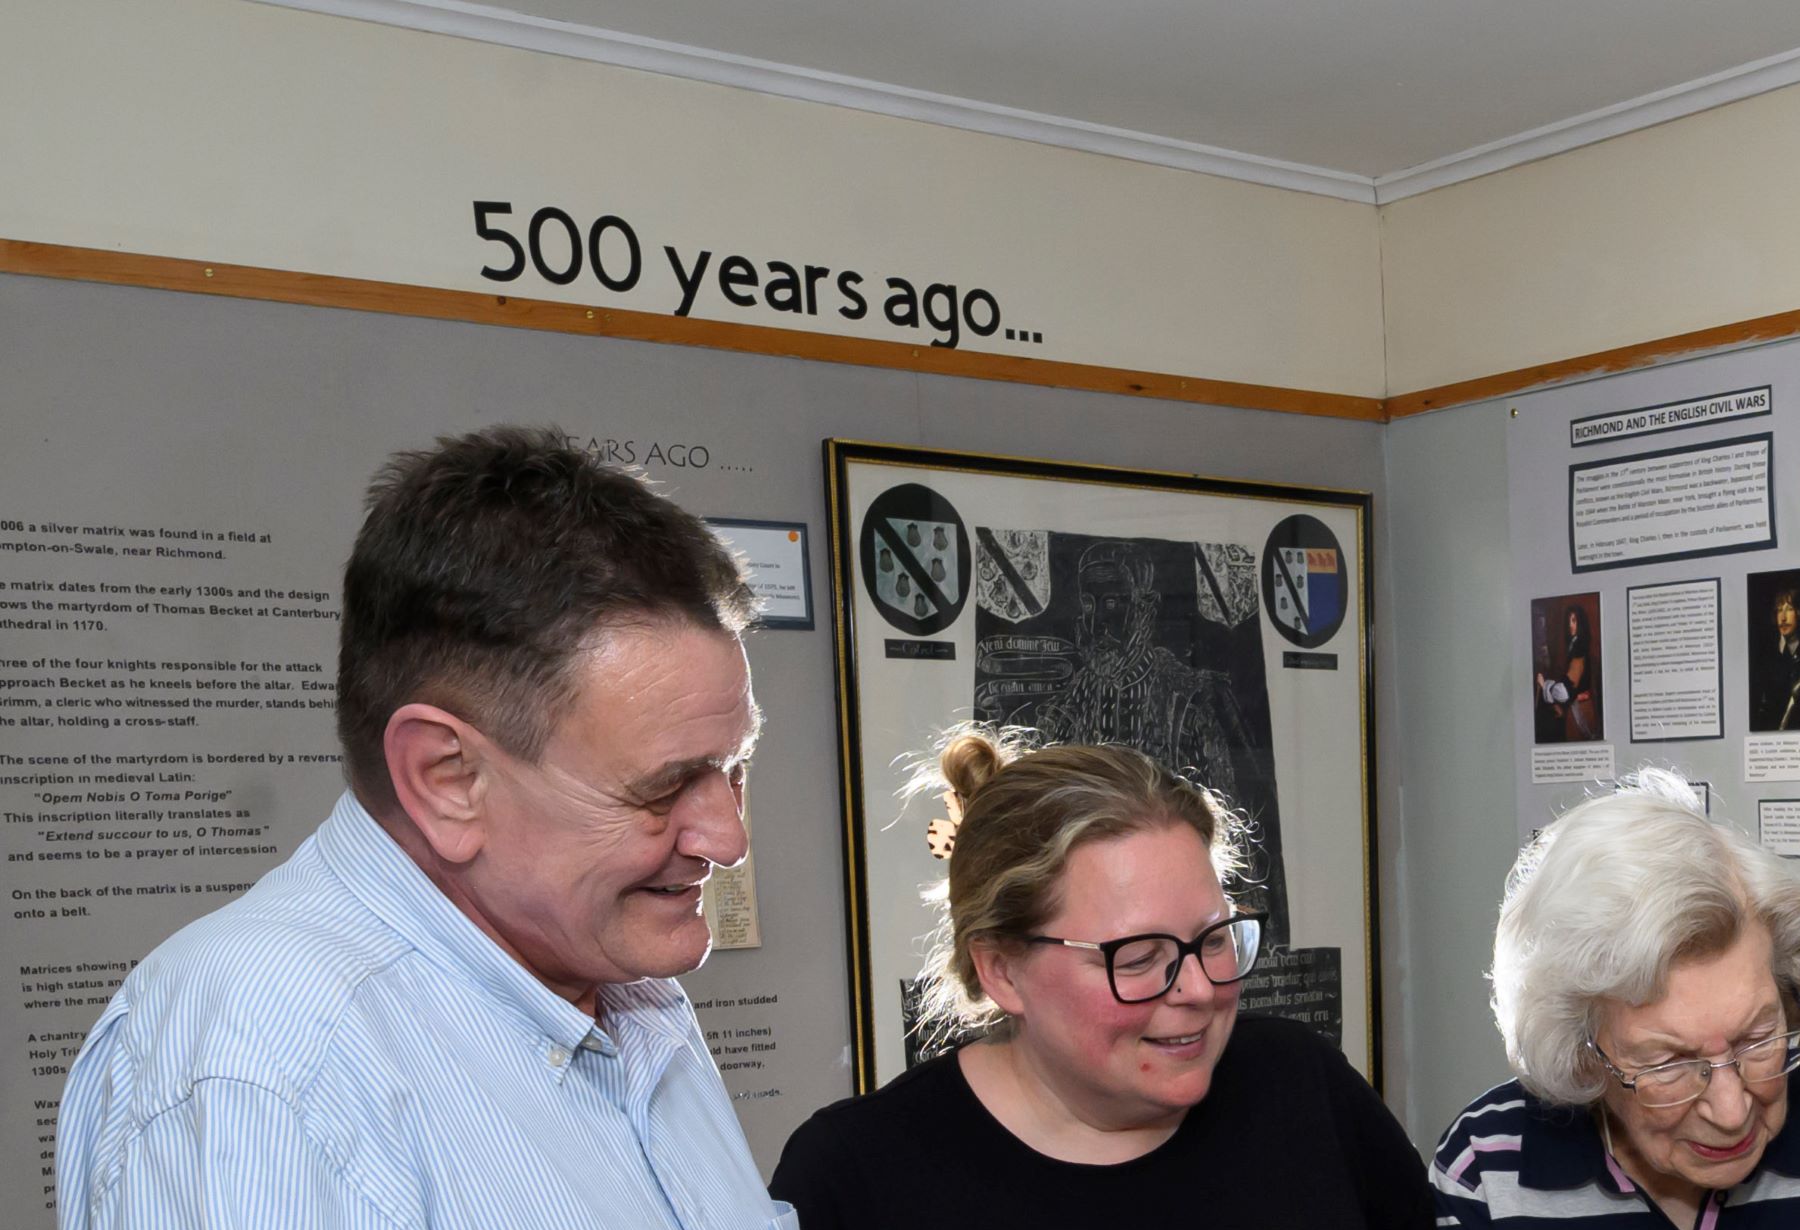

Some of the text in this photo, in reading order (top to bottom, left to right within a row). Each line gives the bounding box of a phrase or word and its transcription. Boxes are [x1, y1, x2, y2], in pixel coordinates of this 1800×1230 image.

[472, 199, 1044, 350] 500 years ago...
[1575, 393, 1766, 440] RICHMOND AND THE ENGLISH CIVIL WARS
[566, 435, 636, 464] EARS
[644, 442, 710, 469] AGO
[28, 524, 36, 532] a
[41, 523, 78, 534] silver
[83, 525, 126, 537] matrix
[129, 528, 155, 538] was
[160, 528, 197, 540] found
[201, 531, 213, 541] in
[217, 533, 225, 541] a
[228, 531, 256, 543] field
[260, 534, 271, 543] at
[123, 547, 151, 556] near
[156, 547, 227, 560] Richmond.
[11, 581, 54, 592] matrix
[59, 581, 96, 592] dates
[100, 583, 131, 594] from
[135, 584, 156, 595] the
[160, 586, 192, 598] early
[197, 586, 233, 597] 1300s
[237, 589, 261, 598] and
[265, 590, 284, 599] the
[288, 590, 330, 602] design
[32, 600, 53, 610] the
[58, 602, 132, 614] martyrdom
[136, 603, 149, 613] of
[154, 603, 205, 615] Thomas
[209, 605, 253, 616] Becket
[257, 607, 268, 617] at
[272, 607, 341, 621] Canterbury
[56, 620, 68, 630] in
[73, 621, 108, 631] 1170.
[0, 753, 344, 767] The scene of the martyrdom is bordered by a reverse
[0, 772, 196, 786] inscription in medieval Latin:
[86, 792, 125, 803] Nobis
[130, 791, 141, 801] O
[146, 791, 180, 801] Toma
[4, 809, 250, 823] This inscription literally translates as
[14, 907, 92, 919] onto a belt.
[694, 994, 778, 1009] and iron studded
[28, 1031, 87, 1042] A chantry
[706, 1026, 771, 1040] 5ft 11 inches)
[29, 1049, 57, 1060] Holy
[725, 1045, 748, 1055] have
[751, 1041, 776, 1052] fitted
[720, 1060, 765, 1071] doorway.
